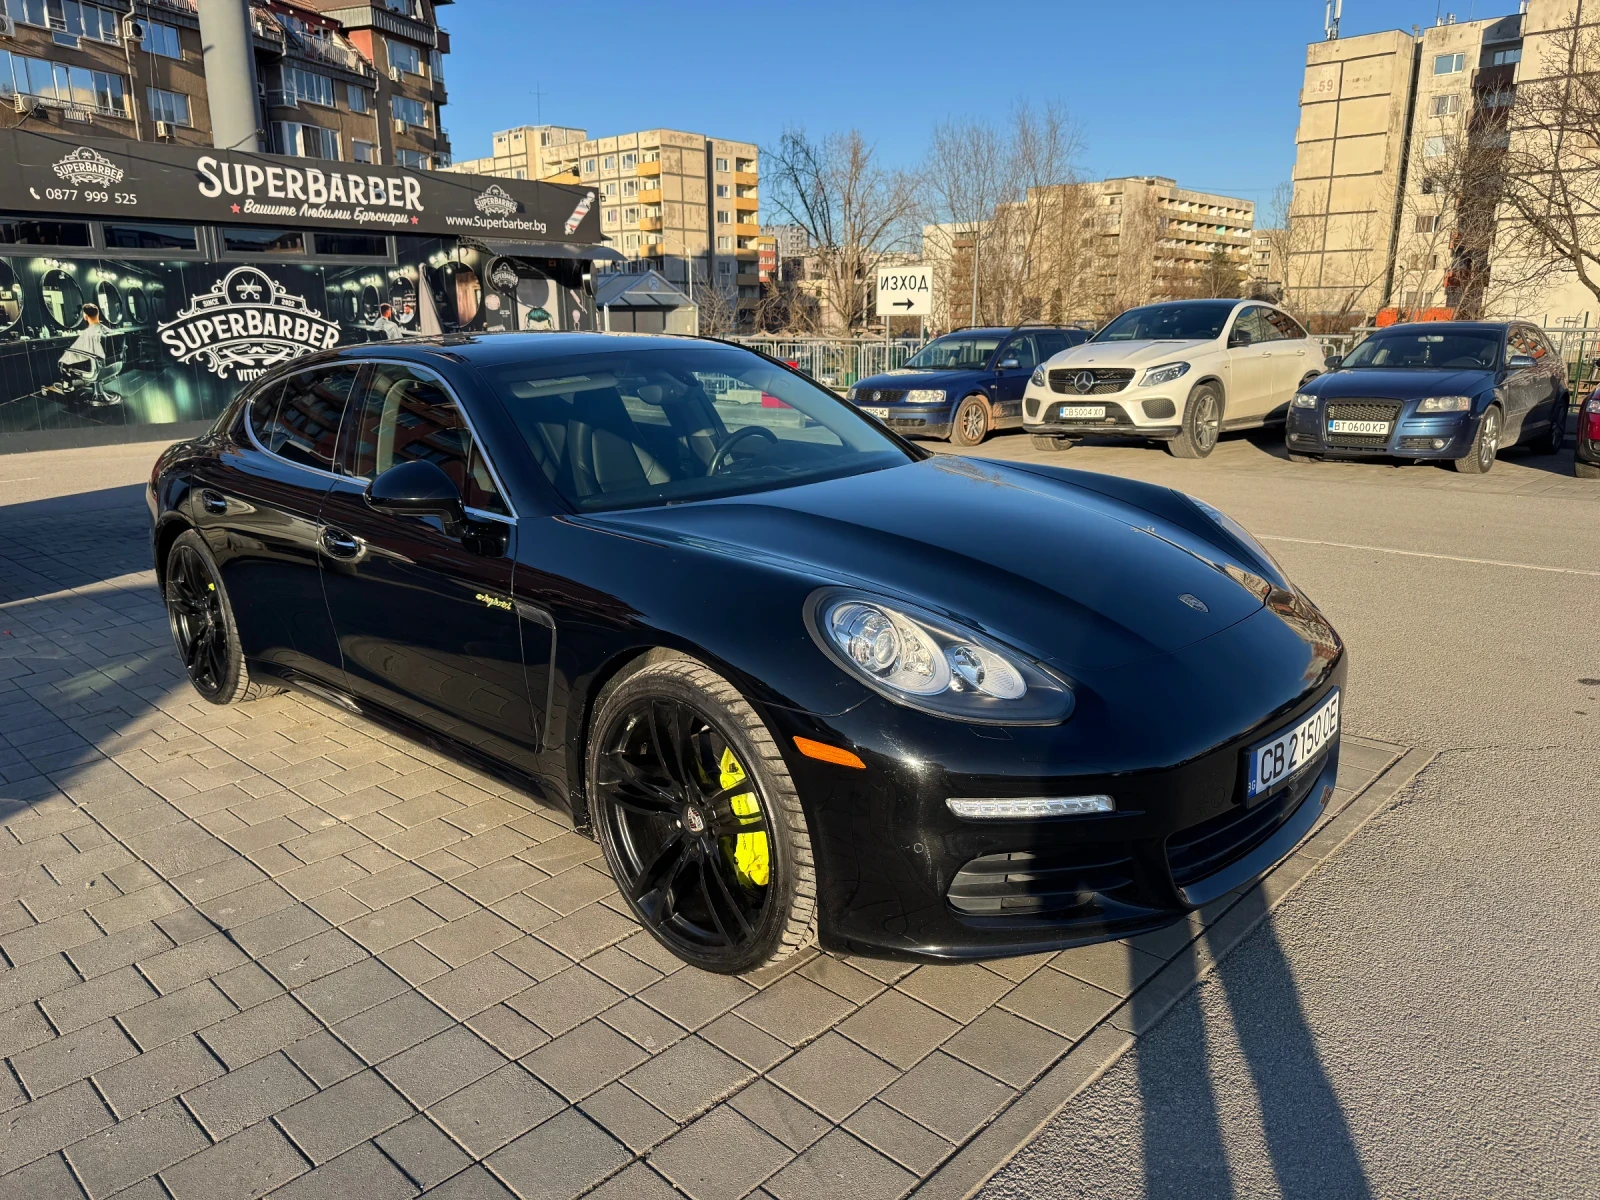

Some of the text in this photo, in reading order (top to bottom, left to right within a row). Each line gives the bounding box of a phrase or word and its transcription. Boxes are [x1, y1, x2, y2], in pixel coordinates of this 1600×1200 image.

[53, 162, 124, 181] SUPERBARBER
[197, 155, 424, 212] SUPERBARBER
[45, 188, 137, 205] 0877 999 525
[243, 199, 409, 227] Вашите Любими Бръснари
[445, 215, 547, 234] www.Superbarber.bg
[880, 275, 929, 292] ИЗХОД
[161, 309, 340, 357] SUPERBARBER
